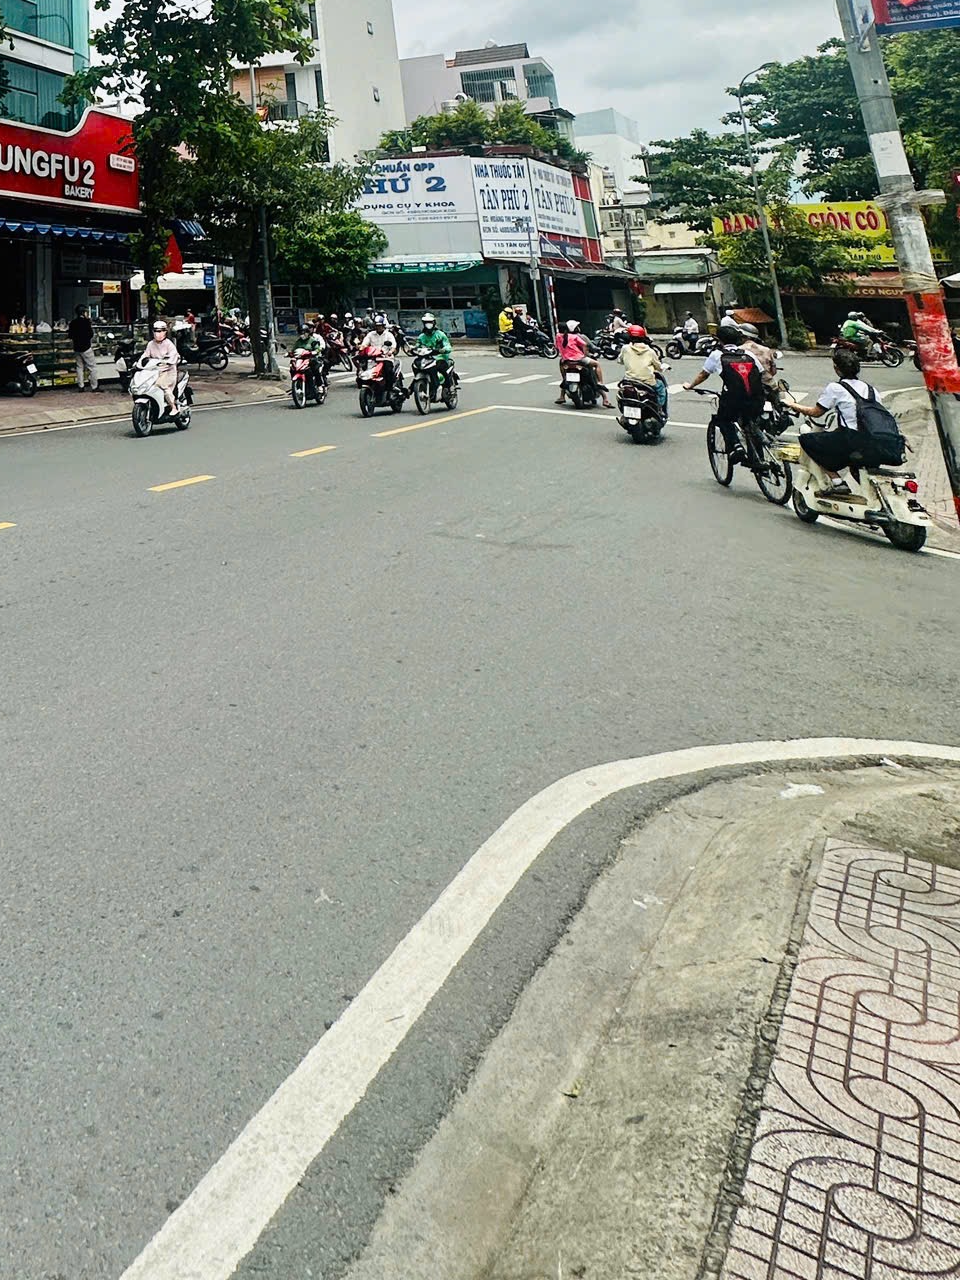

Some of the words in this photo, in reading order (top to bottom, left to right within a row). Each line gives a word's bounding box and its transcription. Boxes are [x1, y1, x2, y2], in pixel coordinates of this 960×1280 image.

[489, 159, 513, 179] THUỐC
[64, 184, 96, 200] BAKERY
[425, 176, 447, 193] 2
[479, 183, 500, 210] TÂN
[500, 183, 521, 211] PHÚ
[522, 188, 530, 210] 2
[534, 184, 554, 211] TÂN
[553, 190, 571, 215] PHÚ
[569, 197, 577, 216] 2
[807, 205, 852, 232] GIÒN
[854, 204, 881, 231] CÔ
[877, 288, 906, 297] NGUY
